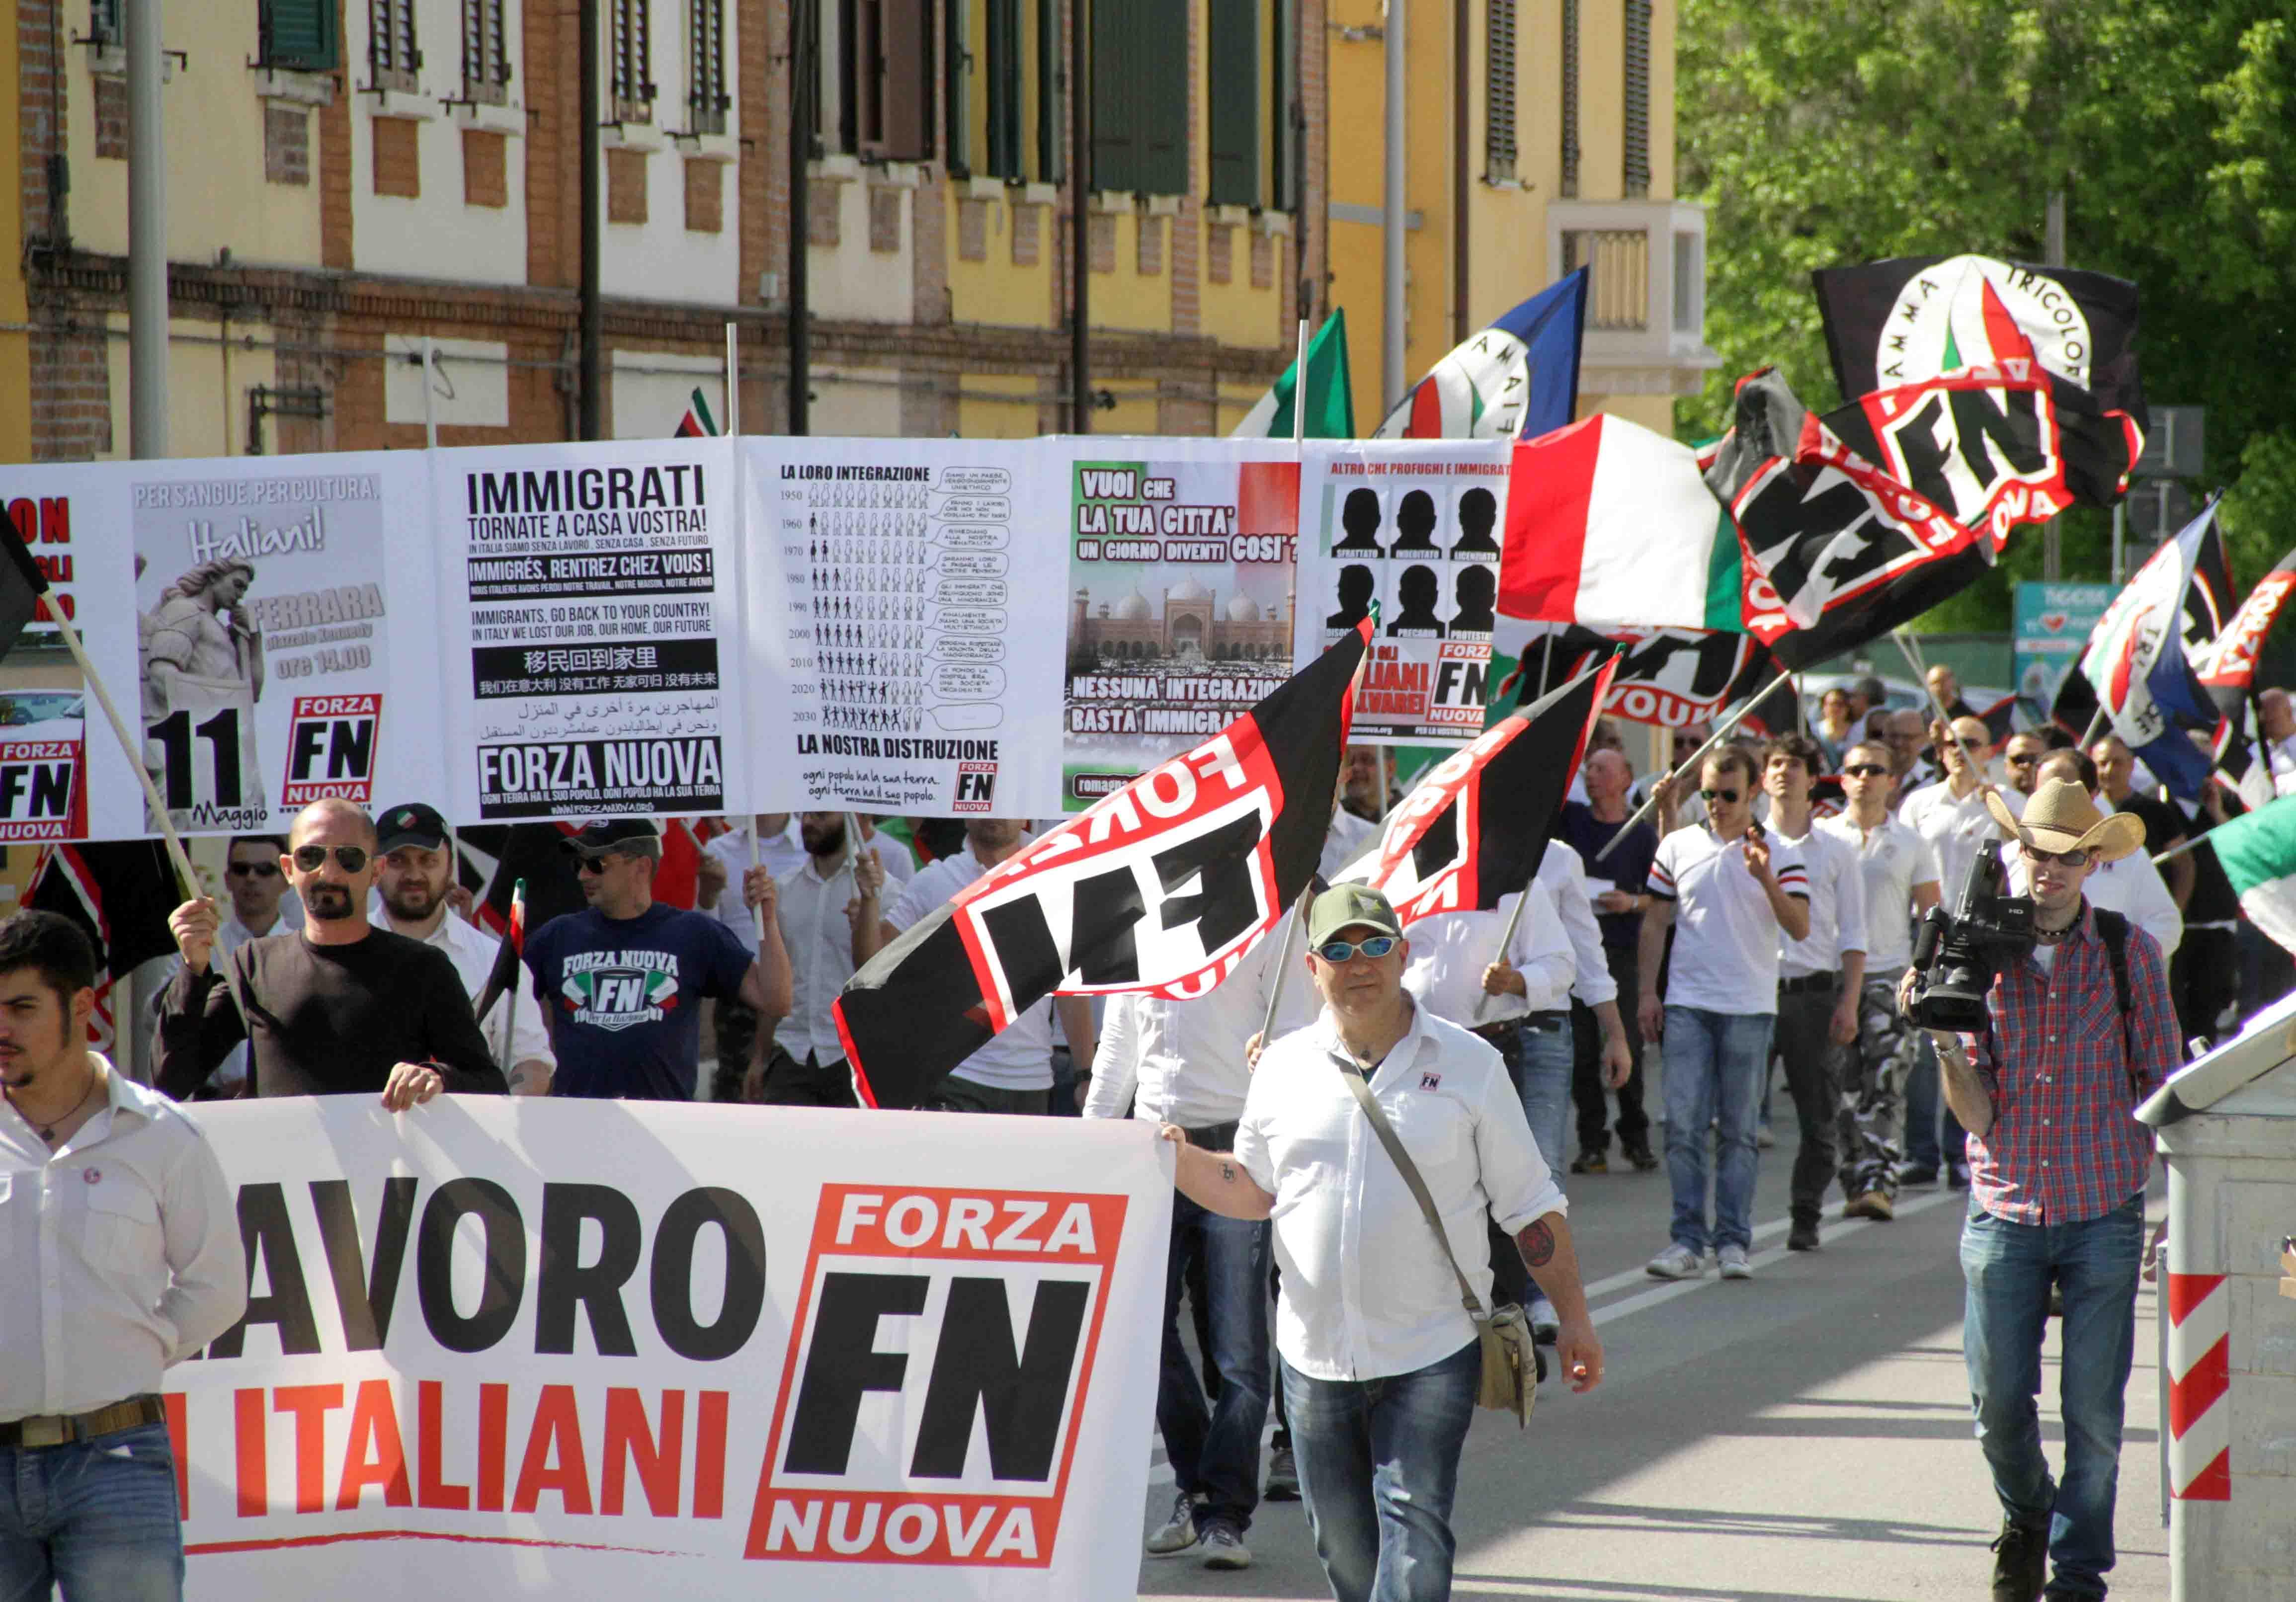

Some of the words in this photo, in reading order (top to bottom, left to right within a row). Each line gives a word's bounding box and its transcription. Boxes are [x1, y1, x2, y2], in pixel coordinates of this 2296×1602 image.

[1883, 278, 1939, 378] AMMA
[2007, 266, 2084, 377] TRICOLOR
[780, 464, 796, 480] LA
[799, 465, 833, 481] LORO
[836, 466, 930, 482] INTEGRAZIONE
[1331, 462, 1365, 476] ALTRO
[1367, 462, 1388, 475] CHE
[1390, 462, 1443, 476] PROFUGHI
[1446, 463, 1452, 475] E
[1455, 463, 1511, 476] IMMIGRAT
[135, 485, 171, 509] PER
[255, 480, 289, 505] PER
[467, 464, 705, 515] IMMIGRATI
[780, 490, 803, 501] 1950
[1081, 470, 1135, 498] VUOI
[1142, 480, 1173, 498] CHE
[467, 515, 550, 541] TORNATE
[556, 514, 568, 538] A
[573, 512, 623, 537] CASA
[626, 508, 707, 535] VOSTRA!
[781, 518, 803, 530] 1960
[1078, 506, 1108, 533] LA
[1112, 506, 1155, 534] TUA
[1162, 507, 1234, 535] CITTA'
[469, 544, 477, 555] IN
[478, 543, 502, 554] ITALIA
[504, 541, 529, 553] SIAMO
[531, 540, 557, 551] SENZA
[596, 538, 621, 549] SENZA
[623, 537, 644, 548] CASA
[650, 536, 676, 547] SENZA
[678, 535, 709, 546] FUTURO
[784, 545, 804, 557] 1970
[1078, 541, 1098, 560] UN
[1105, 542, 1159, 560] GIORNO
[1167, 543, 1225, 561] DIVENTI
[469, 557, 547, 581] IMMIGRÉS,
[551, 557, 618, 578] RENTREZ
[620, 555, 659, 576] CHEZ
[662, 553, 702, 574] VOUS
[786, 572, 806, 584] 1980
[246, 582, 386, 633] FERRARA
[471, 608, 548, 625] IMMIGRANTS,
[551, 607, 566, 623] GO
[569, 606, 599, 622] BACK
[602, 605, 618, 620] TO
[620, 604, 651, 619] YOUR
[653, 601, 711, 619] COUNTRY!
[789, 601, 808, 613] 1990
[472, 628, 483, 641] IN
[484, 627, 509, 641] ITALY
[512, 627, 527, 640] WE
[529, 626, 553, 639] LOST
[555, 625, 574, 638] OUR
[599, 623, 618, 636] OUR
[653, 620, 672, 634] OUR
[675, 619, 712, 633] FUTURE
[788, 628, 811, 640] 2000
[276, 656, 313, 679] ore
[523, 646, 658, 674] 移民回到家里
[790, 656, 813, 668] 2010
[559, 676, 611, 691] 没有工作
[613, 674, 663, 689] 无家可归
[664, 672, 718, 687] 没有未来
[1072, 676, 1159, 699] NESSUNA
[1362, 662, 1429, 692] LIANI
[1433, 661, 1490, 706] FN
[791, 683, 816, 695] 2020
[299, 696, 375, 715] FORZA
[792, 711, 817, 722] 2030
[1071, 709, 1138, 732] BASTA
[3, 743, 73, 759] FORZA
[291, 719, 373, 780] FN
[797, 734, 819, 755] LA
[821, 733, 882, 758] NOSTRA
[884, 737, 998, 761] DISTRUZIONE
[147, 708, 243, 811] 11
[478, 743, 596, 793] FORZA
[604, 739, 722, 787] NUOVA
[961, 763, 995, 772] FORZA
[803, 768, 826, 785] ogni
[828, 767, 854, 784] popolo
[856, 769, 870, 782] ha
[871, 768, 880, 783] la
[882, 775, 901, 784] sua
[902, 769, 941, 786] terra.
[957, 773, 995, 801] FN
[0, 763, 72, 818] FN
[287, 784, 367, 803] NUOVA
[482, 794, 500, 805] OGNI
[502, 793, 529, 804] TERRA
[530, 792, 542, 801] HA
[543, 791, 551, 801] IL
[552, 790, 569, 801] SUO
[570, 788, 602, 801] POPOLO,
[603, 787, 622, 799] OGNI
[623, 787, 652, 798] POPOLO
[653, 787, 664, 797] HA
[664, 786, 676, 797] LA
[676, 785, 693, 797] SUA
[694, 784, 721, 796] TERRA
[808, 785, 830, 800] ogni
[833, 782, 860, 796] terra
[862, 785, 876, 798] ha
[877, 784, 883, 799] il
[884, 790, 901, 800] suo
[903, 787, 937, 805] popolo.
[192, 799, 268, 831] Maggio
[954, 802, 990, 811] NUOVA
[562, 951, 617, 978] FORZA
[620, 950, 679, 977] NUOVA
[596, 978, 643, 1012] FN
[1421, 1077, 1439, 1087] FN
[834, 1193, 1097, 1254] FORZA
[185, 1176, 767, 1362] AVORO
[782, 1271, 1091, 1483] FN
[234, 1378, 730, 1520] ITALIANI
[764, 1498, 1039, 1559] NUOVA
